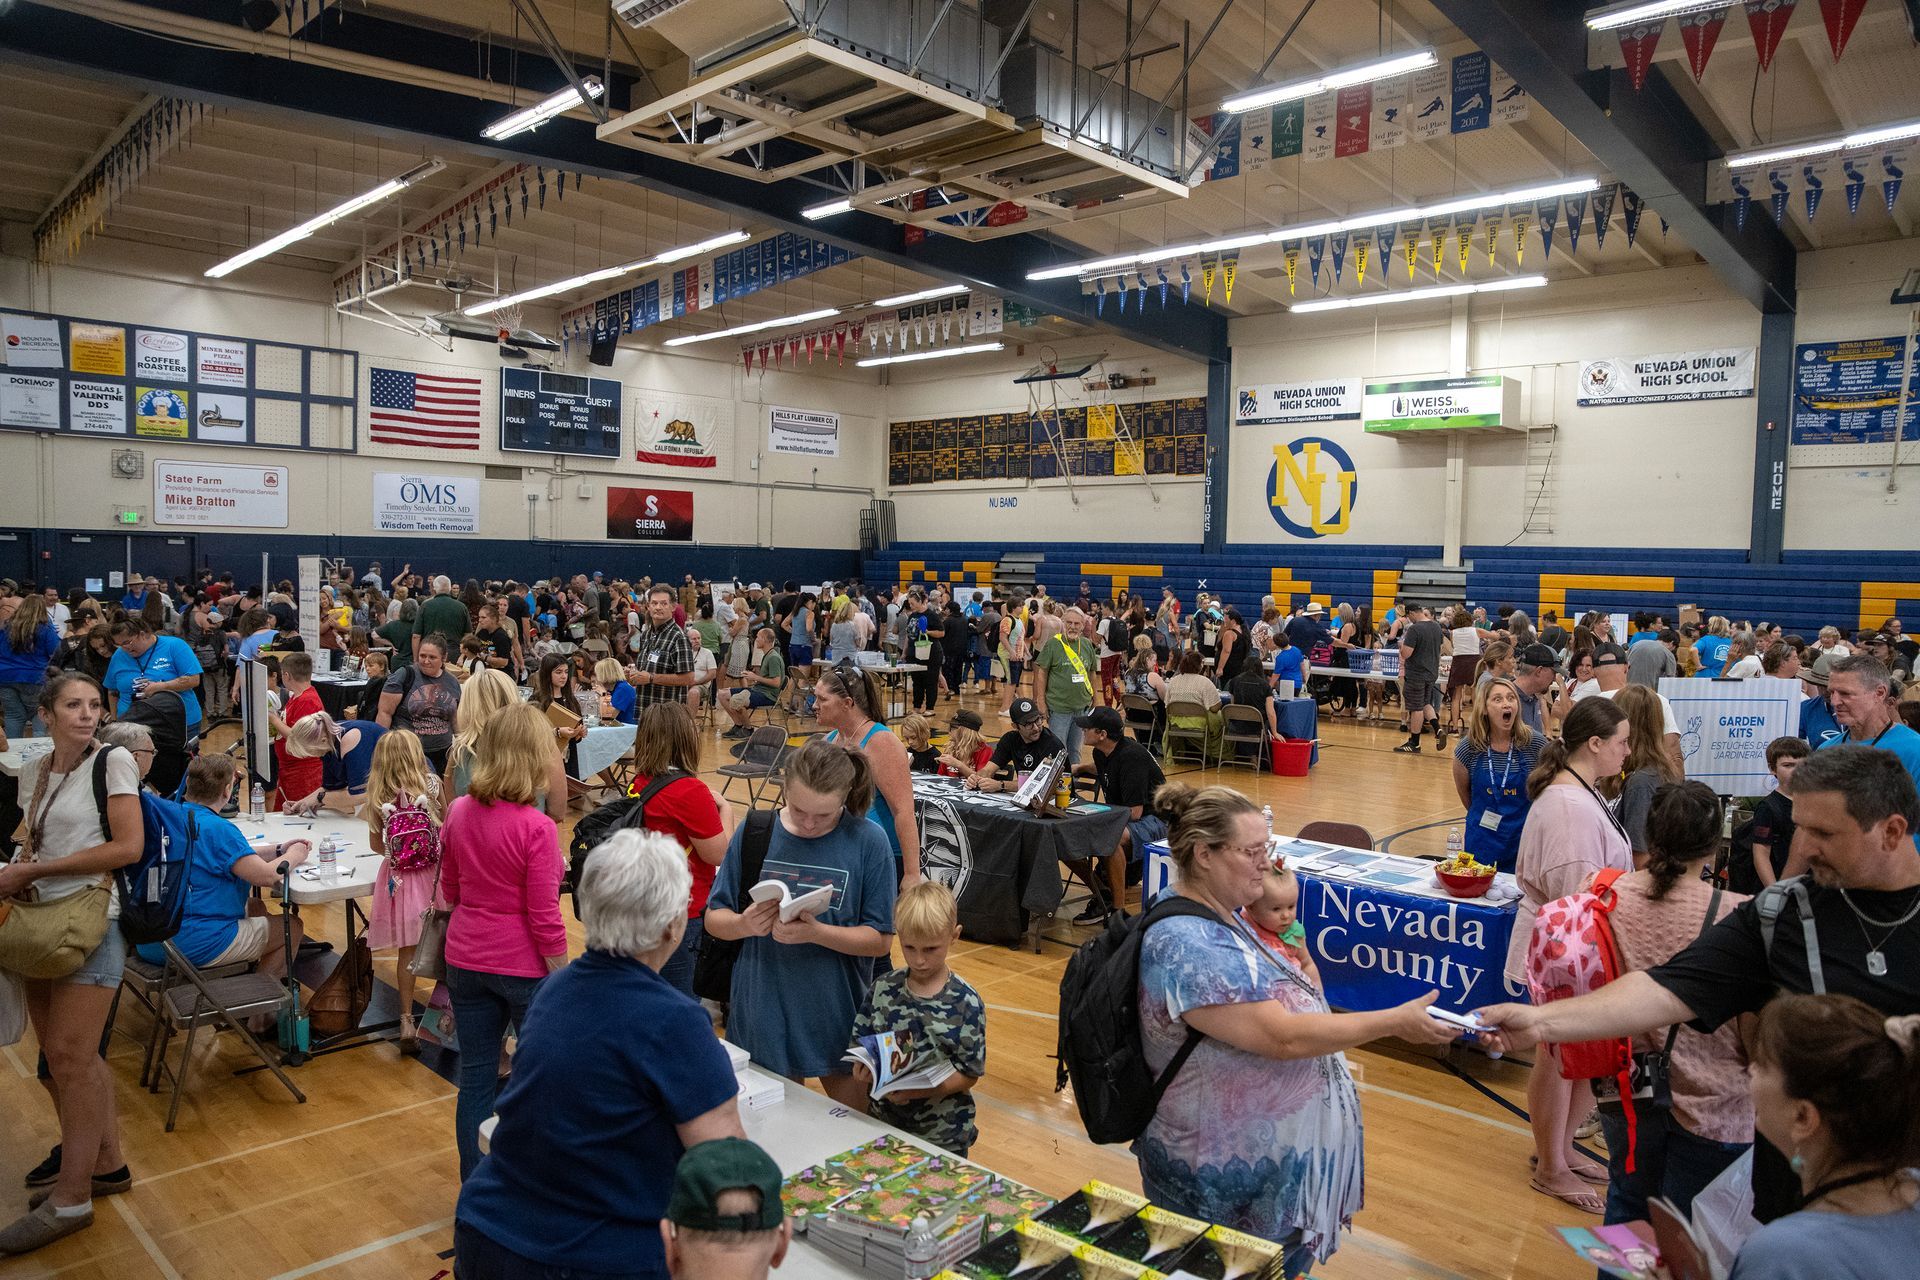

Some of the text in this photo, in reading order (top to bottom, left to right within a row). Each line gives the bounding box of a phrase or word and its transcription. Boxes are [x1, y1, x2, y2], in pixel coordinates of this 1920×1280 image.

[1508, 104, 1526, 114] Place
[1430, 119, 1448, 129] Place
[1460, 117, 1480, 129] 2017
[1408, 240, 1416, 266] SFL
[1461, 234, 1469, 261] SFL
[1357, 247, 1365, 273] SFL
[144, 355, 180, 366] COFFEE
[1634, 356, 1737, 374] NEVADA UNION
[137, 362, 187, 373] ROASTERS
[1640, 371, 1729, 388] HIGH SCHOOL
[75, 383, 114, 394] DOUGLAS
[504, 388, 536, 400] MINERS
[1273, 386, 1346, 401] NEVADA UNION
[73, 391, 124, 402] VALENTINE
[554, 397, 575, 405] PERIOD
[1411, 396, 1453, 408] WEISS
[1588, 396, 1627, 405] NATIONALLY
[1628, 393, 1665, 403] RECOGNIZED
[1666, 391, 1692, 401] SCHOOL
[1702, 388, 1743, 398] EXCELLENCE
[87, 401, 110, 409] DDS
[539, 402, 560, 410] BONUS
[584, 397, 613, 408] GUEST
[1279, 397, 1342, 411] HIGH SCHOOL
[569, 405, 590, 413] BONUS
[1410, 405, 1470, 417] LANDSCAPING
[506, 416, 526, 424] FOULS
[539, 411, 556, 419] POSS
[572, 414, 589, 422] POSS
[775, 412, 791, 420] HILLS
[792, 413, 804, 421] FLAT
[805, 415, 825, 424] LUMBER
[549, 419, 572, 428] PLAYER
[574, 422, 589, 430] FOUL
[602, 425, 620, 433] FOULS
[654, 445, 705, 455] CALIFORNIA REPUBLIC
[775, 445, 835, 456] www.hillsflatlumber.com
[165, 474, 222, 485] State Farm
[400, 475, 423, 483] Sierra
[165, 484, 191, 492] Providing
[1271, 442, 1356, 535] NU
[1771, 461, 1784, 510] HOME
[400, 482, 457, 505] OMS
[1204, 458, 1213, 532] VISITORS
[165, 493, 236, 507] Mike Bratton
[989, 497, 1018, 508] NU BAND
[385, 503, 412, 513] Timothy
[414, 504, 437, 513] Snyder,
[458, 505, 471, 513] MD
[123, 511, 138, 523] EXIT
[380, 521, 474, 532] Wisdom Teeth Removal
[635, 518, 667, 530] SIERRA
[1719, 716, 1766, 727] GARDEN
[1728, 728, 1754, 739] KITS
[1710, 741, 1768, 751] ESTUCHES DE
[1317, 881, 1488, 951] Nevada
[1315, 925, 1486, 1005] County
